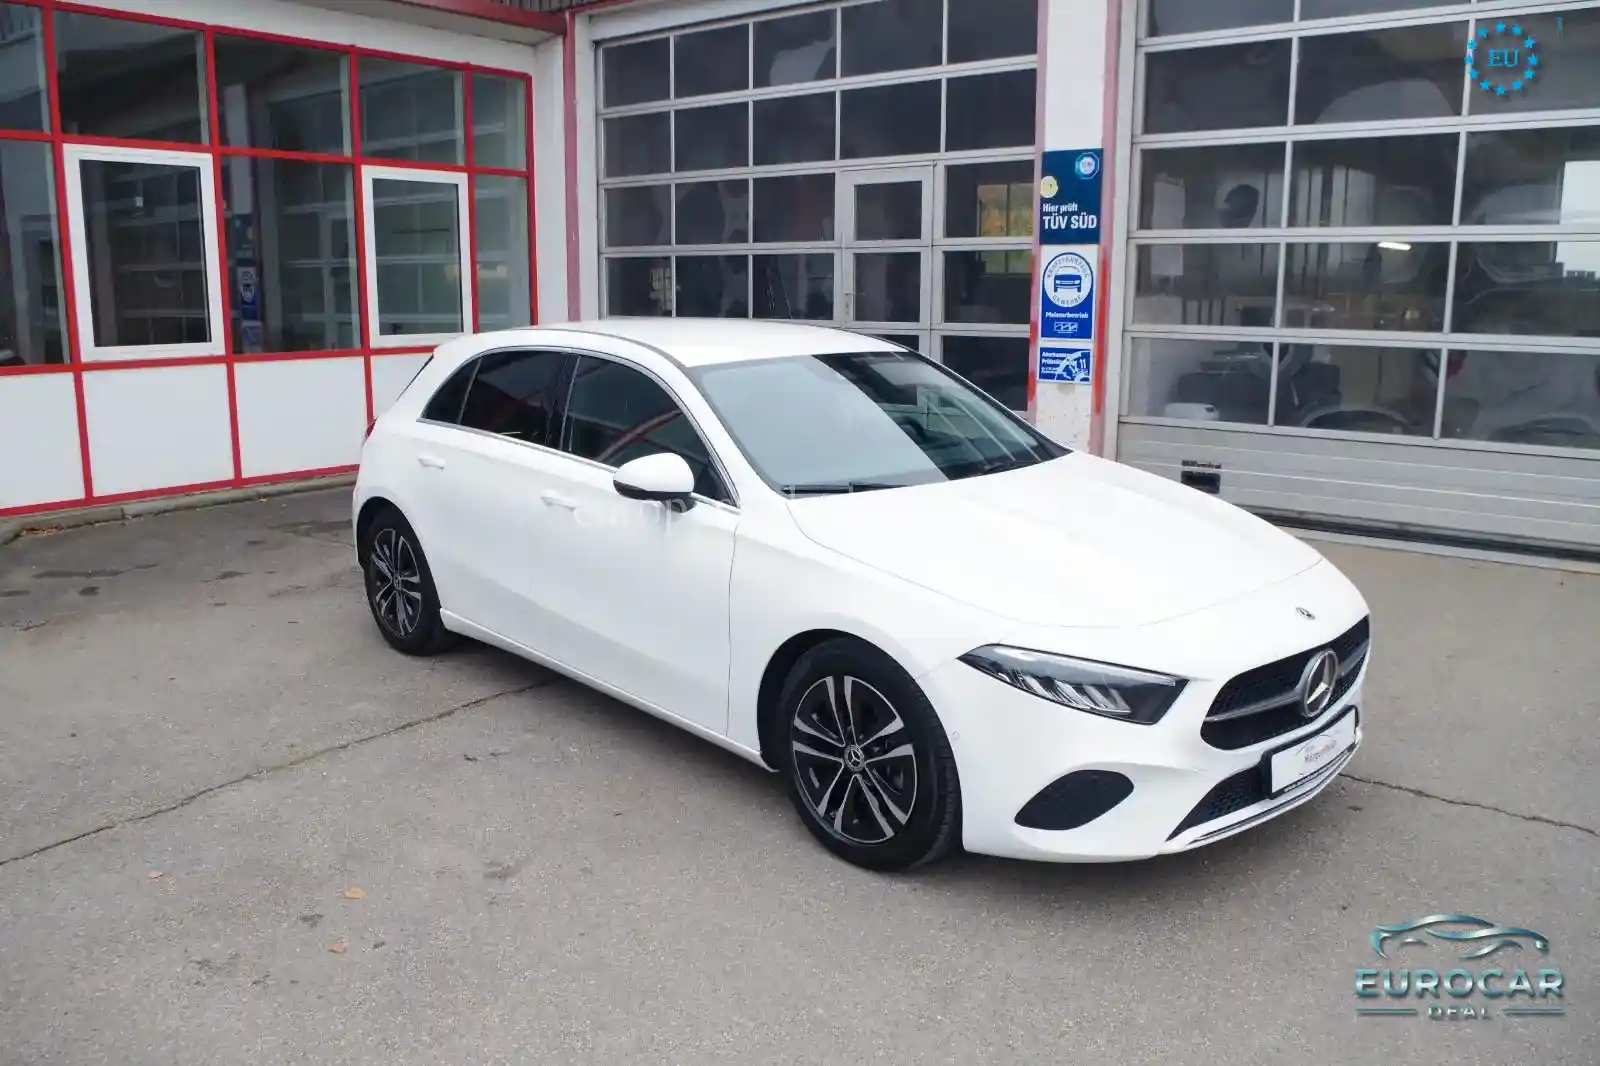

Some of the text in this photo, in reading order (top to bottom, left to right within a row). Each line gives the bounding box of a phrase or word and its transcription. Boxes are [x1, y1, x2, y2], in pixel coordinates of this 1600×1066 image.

[1043, 202, 1078, 214] Hier prüft
[1043, 212, 1097, 229] TÜV SÜD
